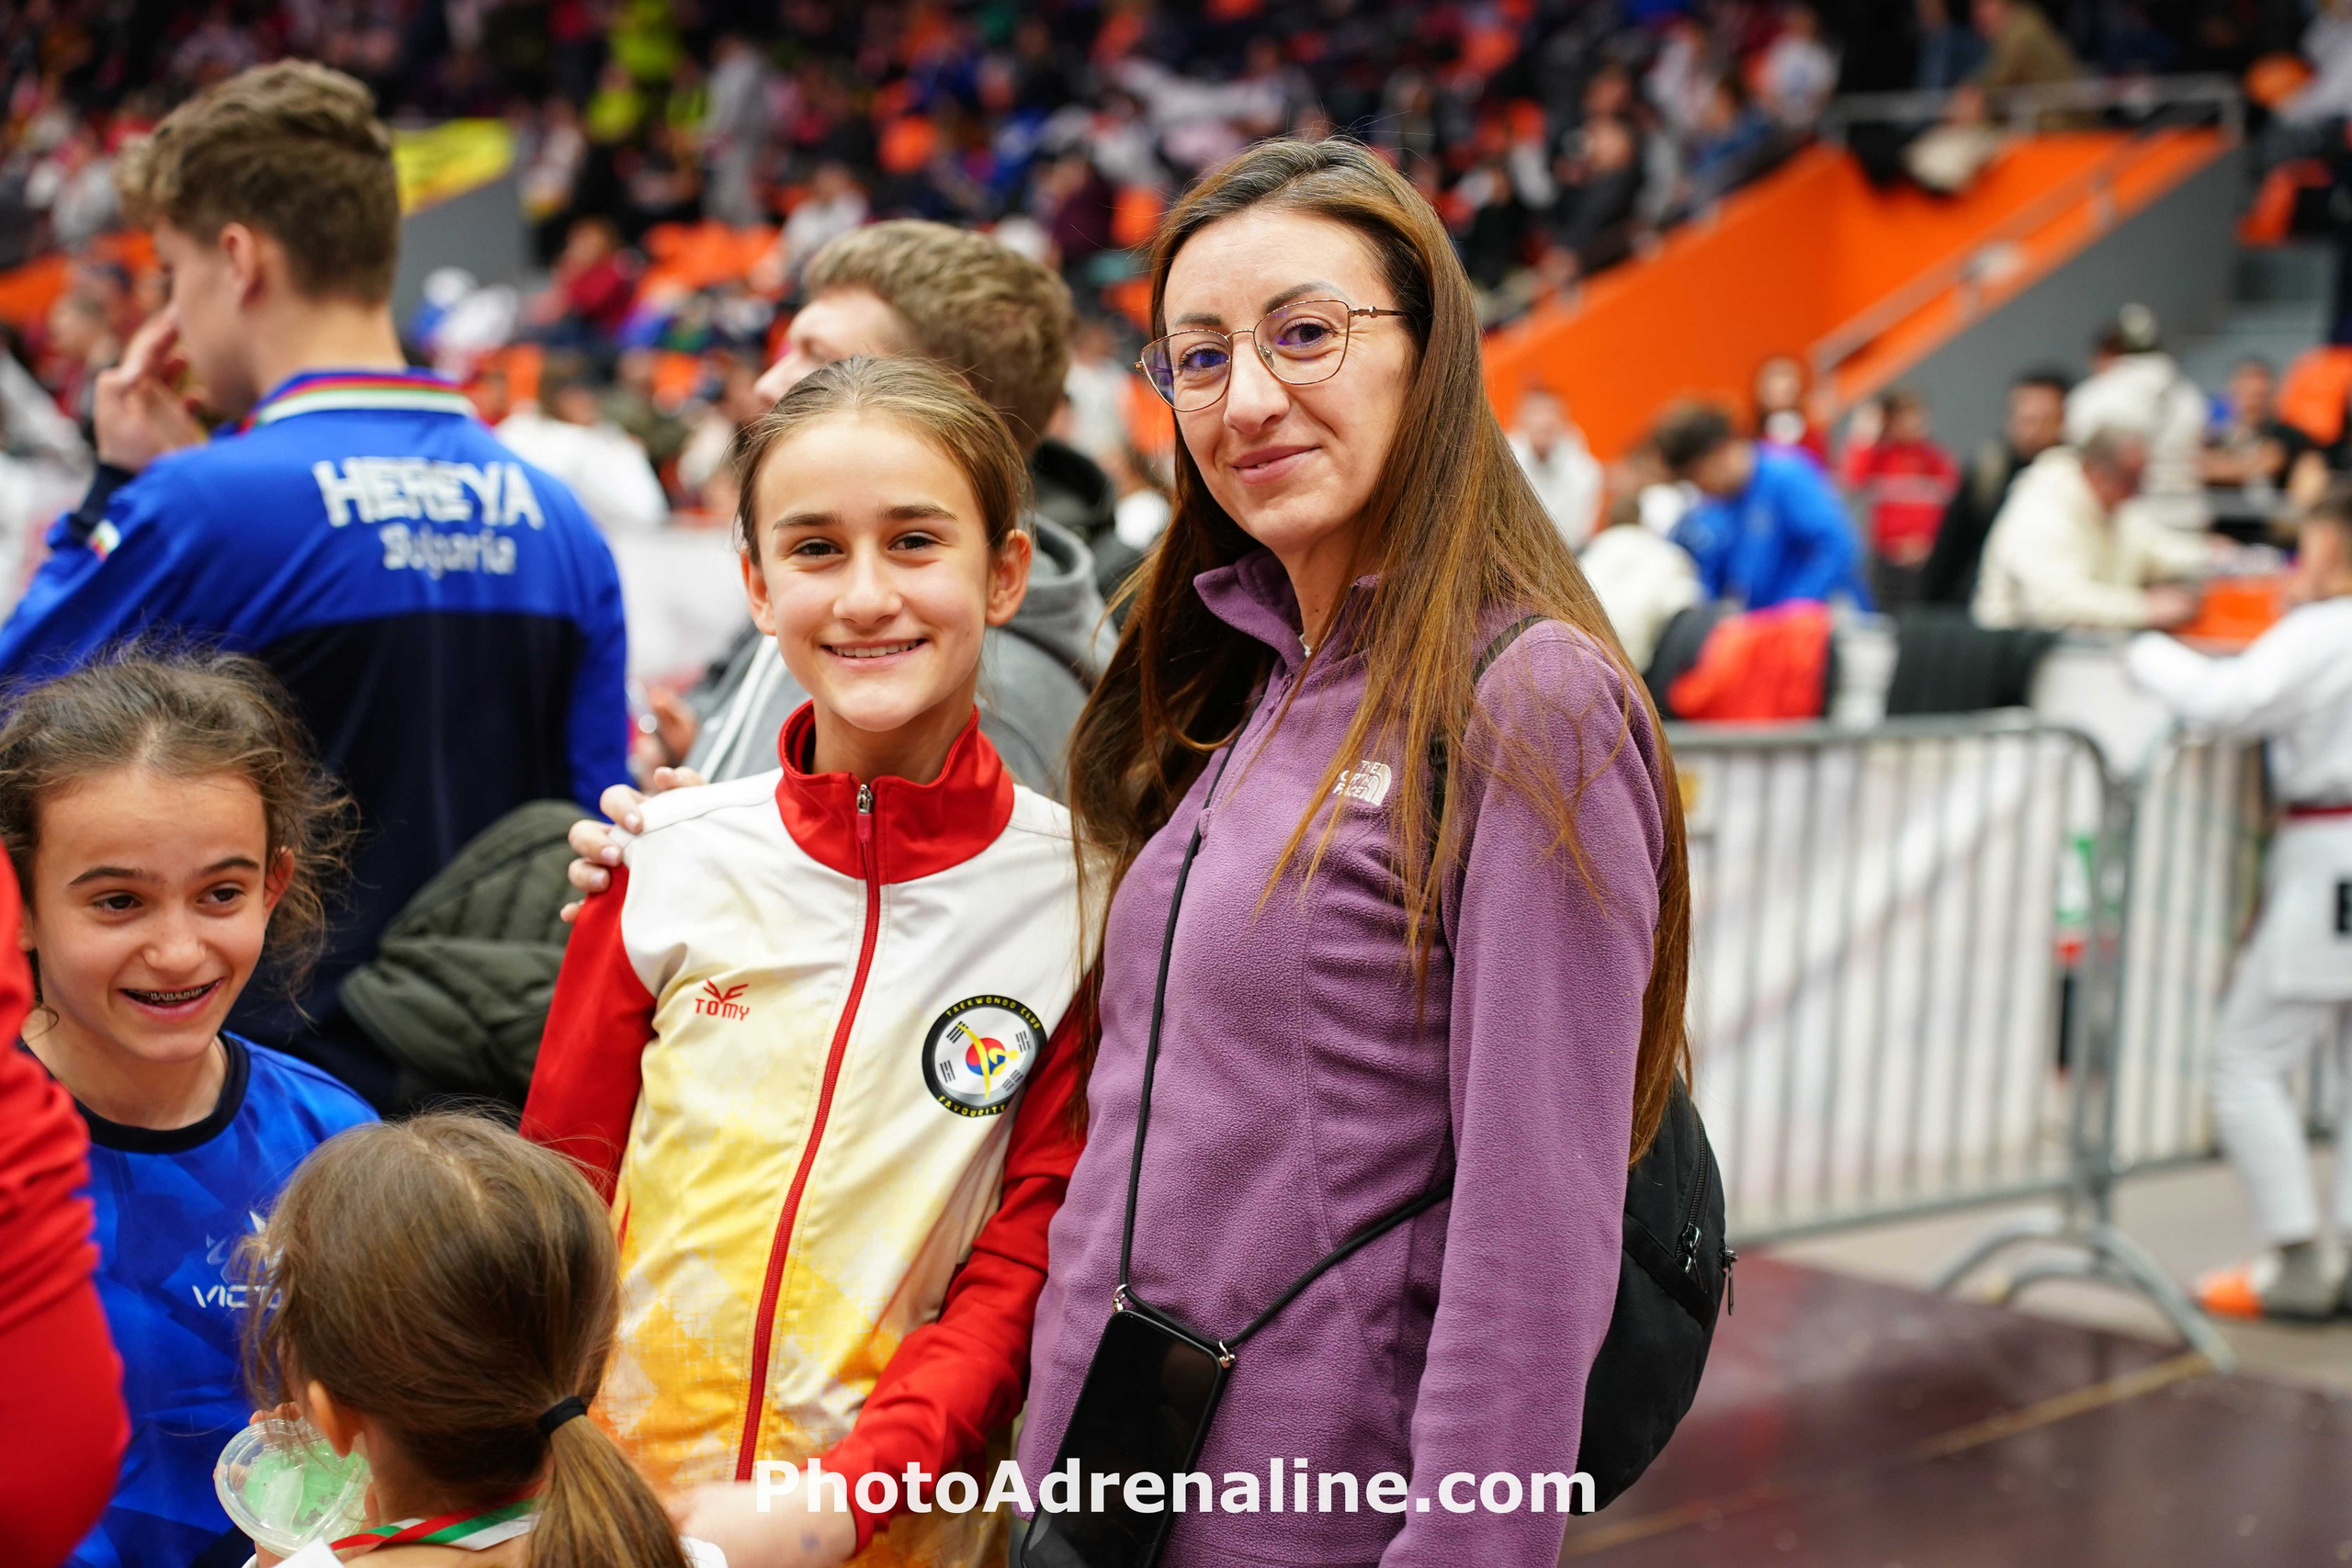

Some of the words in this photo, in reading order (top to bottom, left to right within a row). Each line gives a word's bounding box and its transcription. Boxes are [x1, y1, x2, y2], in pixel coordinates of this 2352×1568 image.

[695, 998, 750, 1021] TOMY
[945, 996, 1017, 1017] TAEKWONDO
[1019, 1007, 1041, 1030] CLUB
[191, 1284, 283, 1309] VICTO
